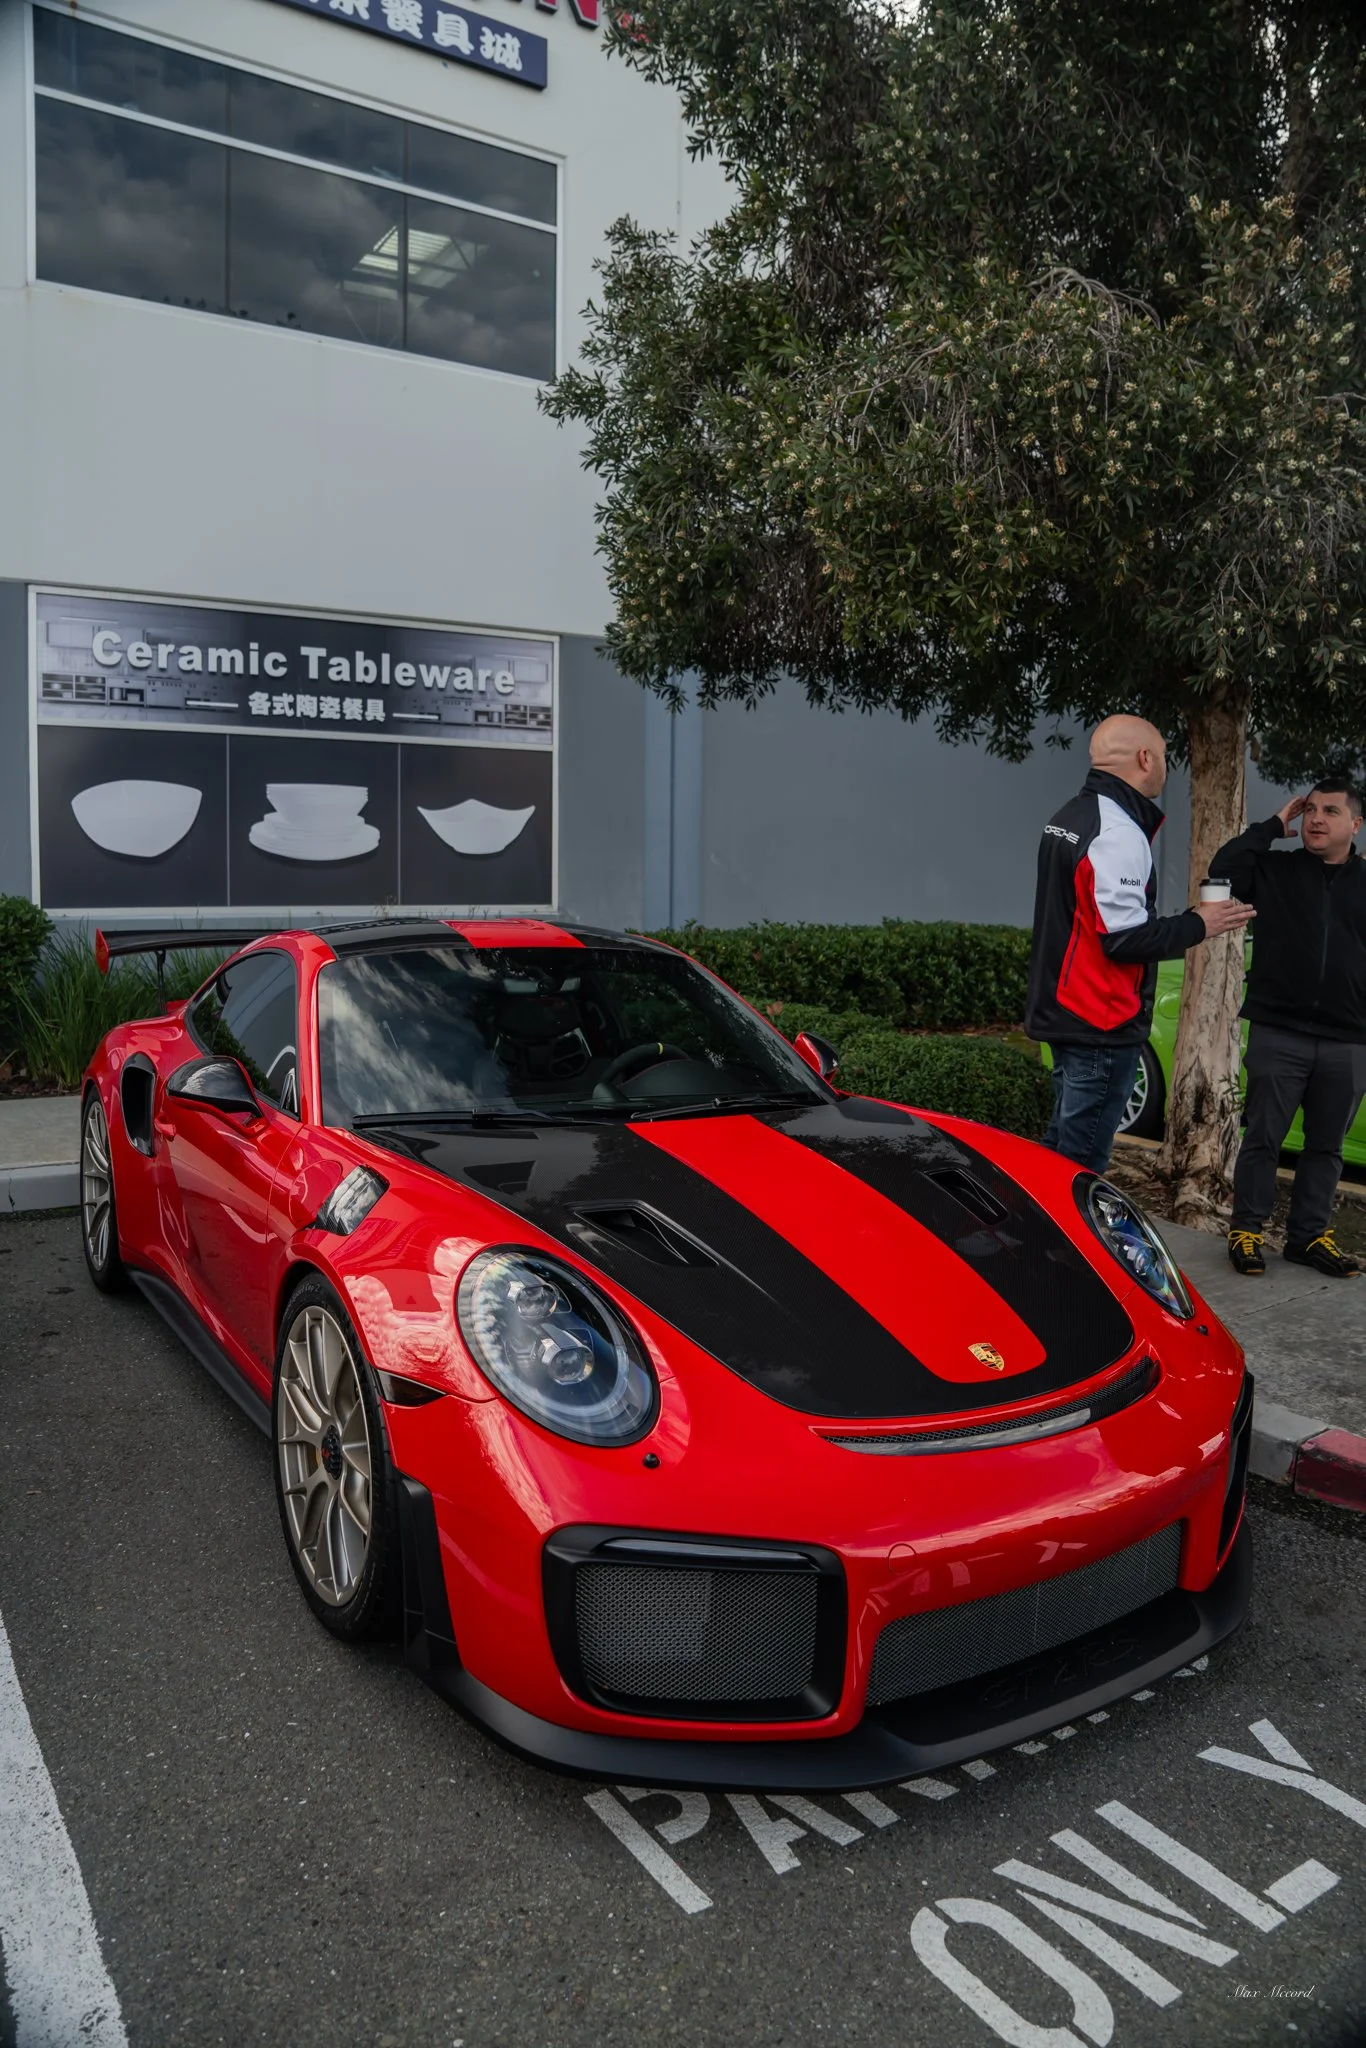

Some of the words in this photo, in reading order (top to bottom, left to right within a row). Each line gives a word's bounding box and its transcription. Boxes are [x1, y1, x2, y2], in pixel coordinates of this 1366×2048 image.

[92, 630, 288, 678] Ceramic
[300, 646, 515, 694] Tableware
[248, 691, 386, 722] 各式陶瓷餐具
[1120, 878, 1141, 887] Mobil
[910, 1718, 1366, 2048] ONLY
